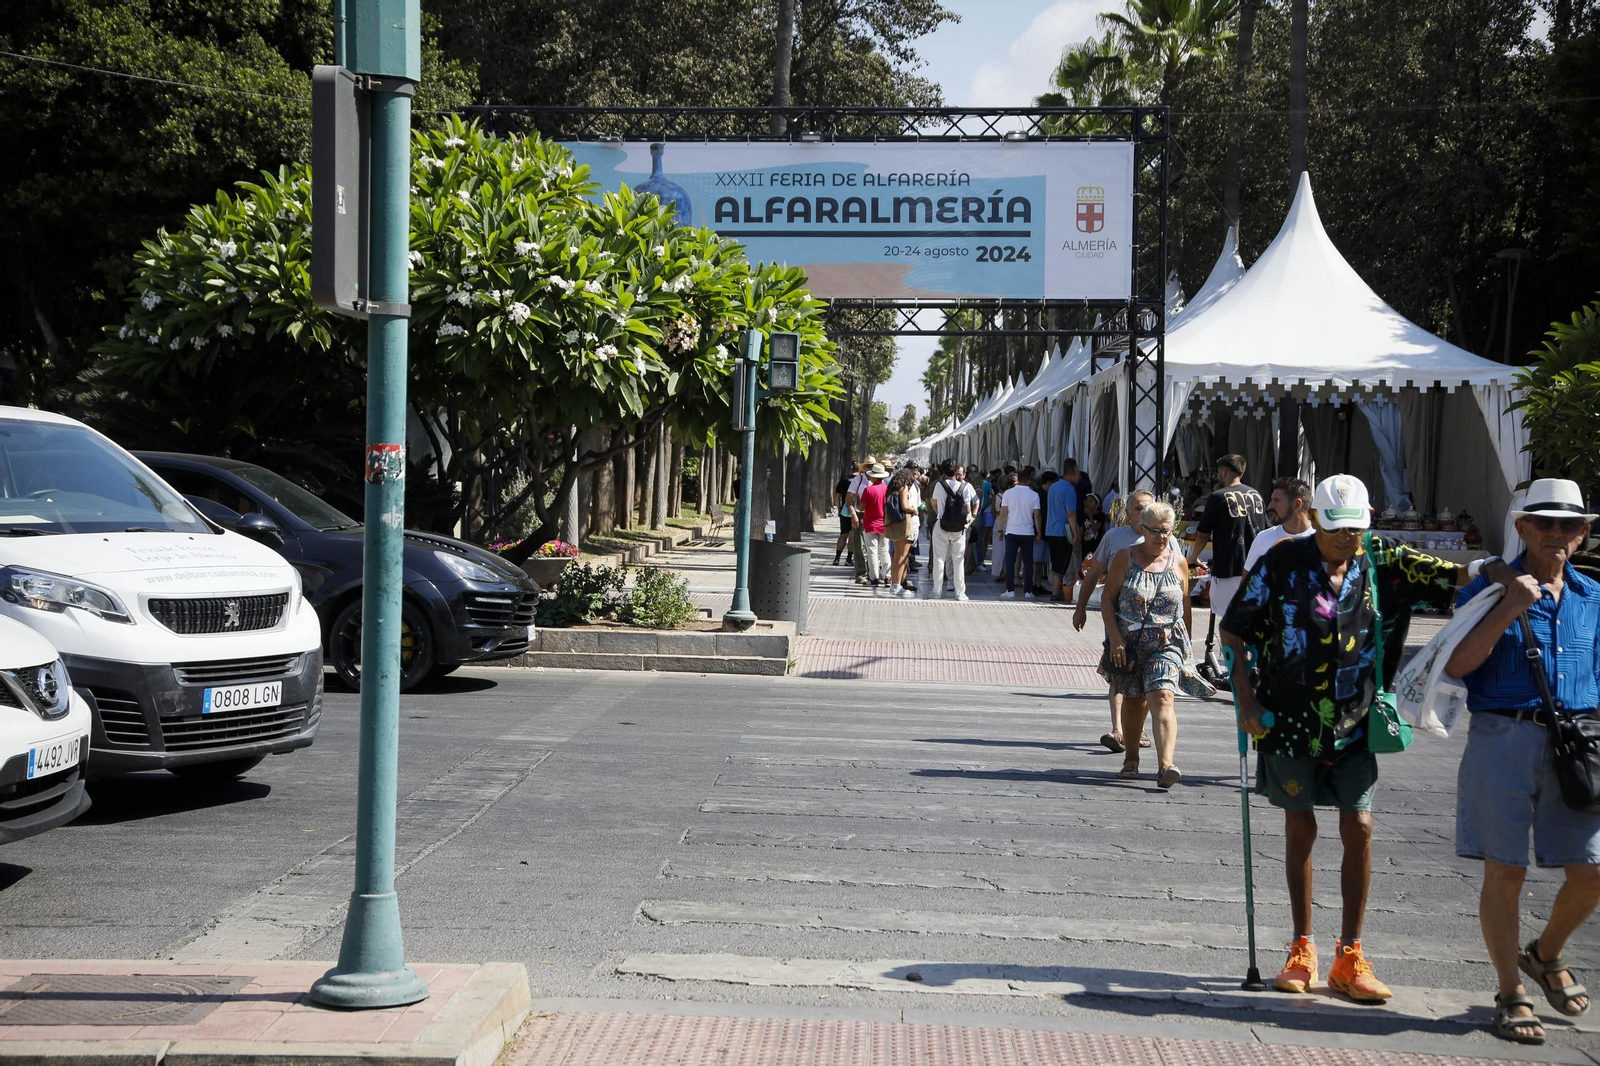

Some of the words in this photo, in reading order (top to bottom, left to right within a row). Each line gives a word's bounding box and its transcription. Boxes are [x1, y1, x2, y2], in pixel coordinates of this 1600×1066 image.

[715, 172, 764, 187] XXXII
[770, 172, 825, 187] FERIA
[832, 172, 857, 187] DE
[862, 169, 971, 187] ALFARERÍA
[714, 189, 1032, 223] ALFARALMERÍA
[1062, 238, 1117, 251] ALMERÍA
[883, 245, 921, 257] 20-24
[924, 246, 969, 260] agosto
[976, 245, 1032, 263] 2024
[1075, 251, 1104, 259] CIUDAD
[214, 688, 249, 708] 0808
[254, 685, 279, 704] LGN
[37, 744, 62, 771] 4492
